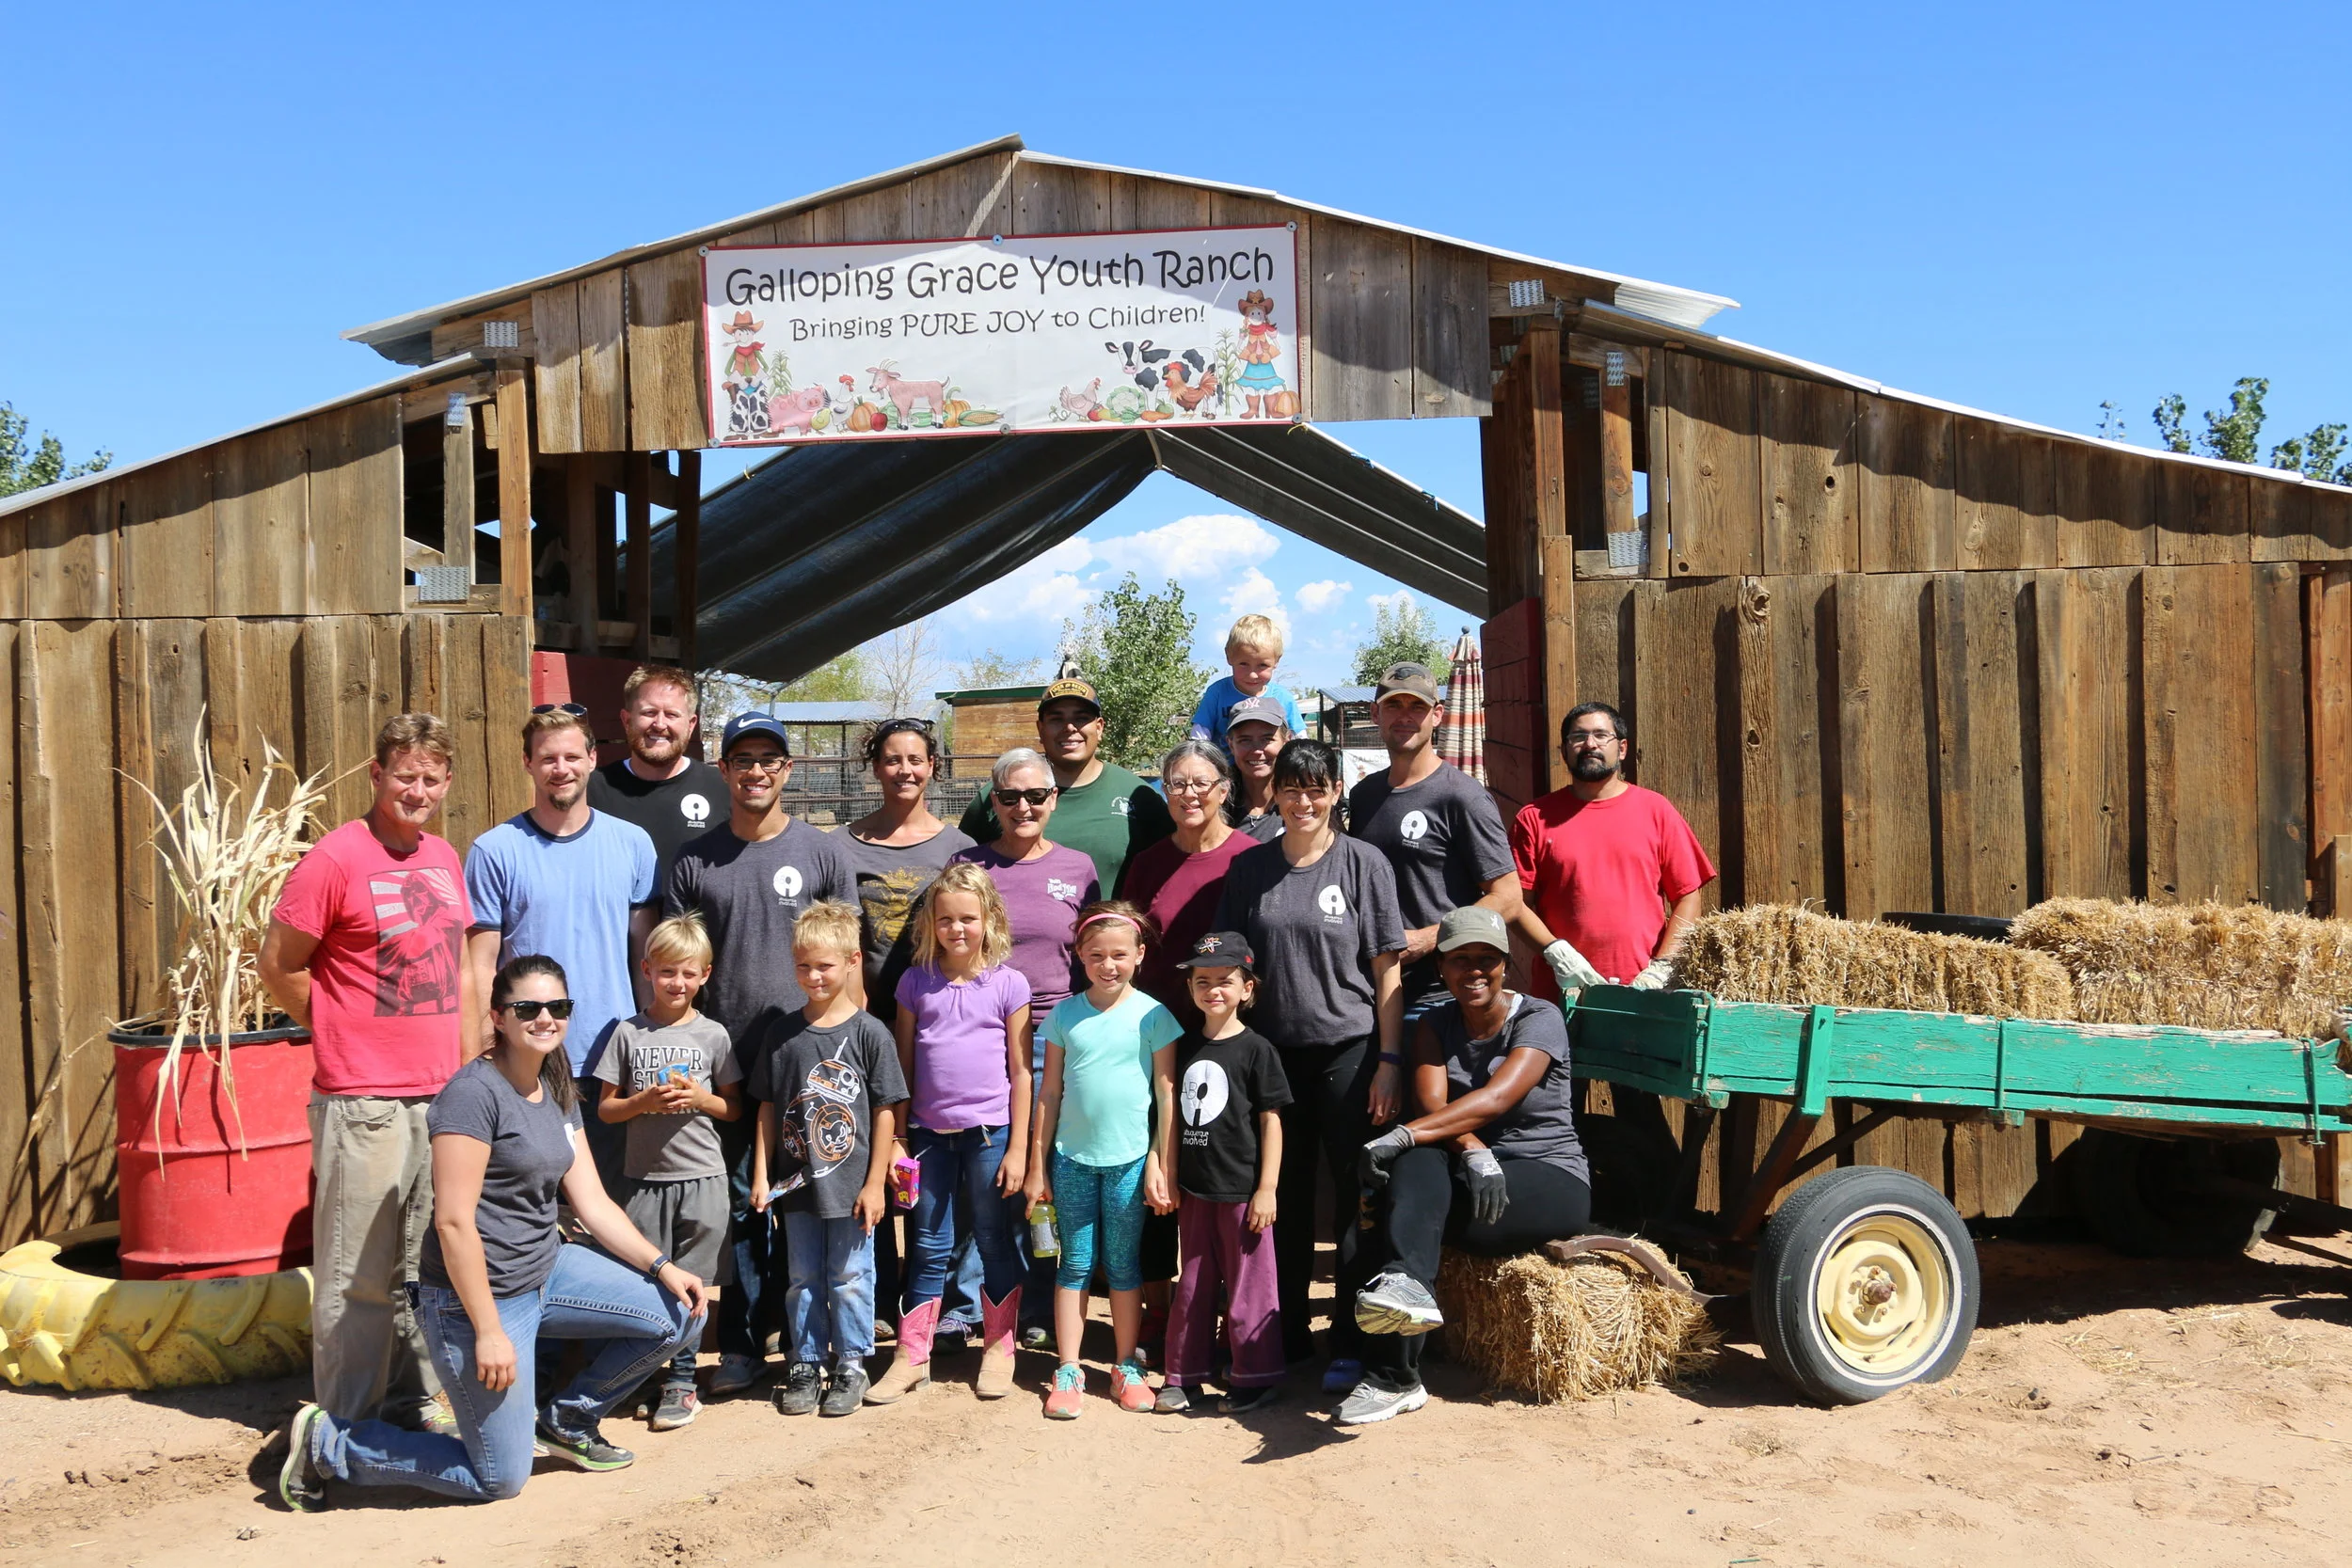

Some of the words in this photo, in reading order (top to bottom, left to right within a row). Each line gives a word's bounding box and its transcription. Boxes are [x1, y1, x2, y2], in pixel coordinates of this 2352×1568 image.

[726, 263, 895, 306] Galloping
[908, 261, 1018, 298] Grace
[1029, 252, 1144, 295] Youth
[1152, 246, 1274, 289] Ranch
[789, 316, 893, 341] Bringing
[899, 311, 978, 337] PURE
[987, 309, 1044, 333] JOY
[1051, 311, 1079, 327] to
[1089, 305, 1205, 329] Children!
[1183, 1136, 1209, 1147] nvolved
